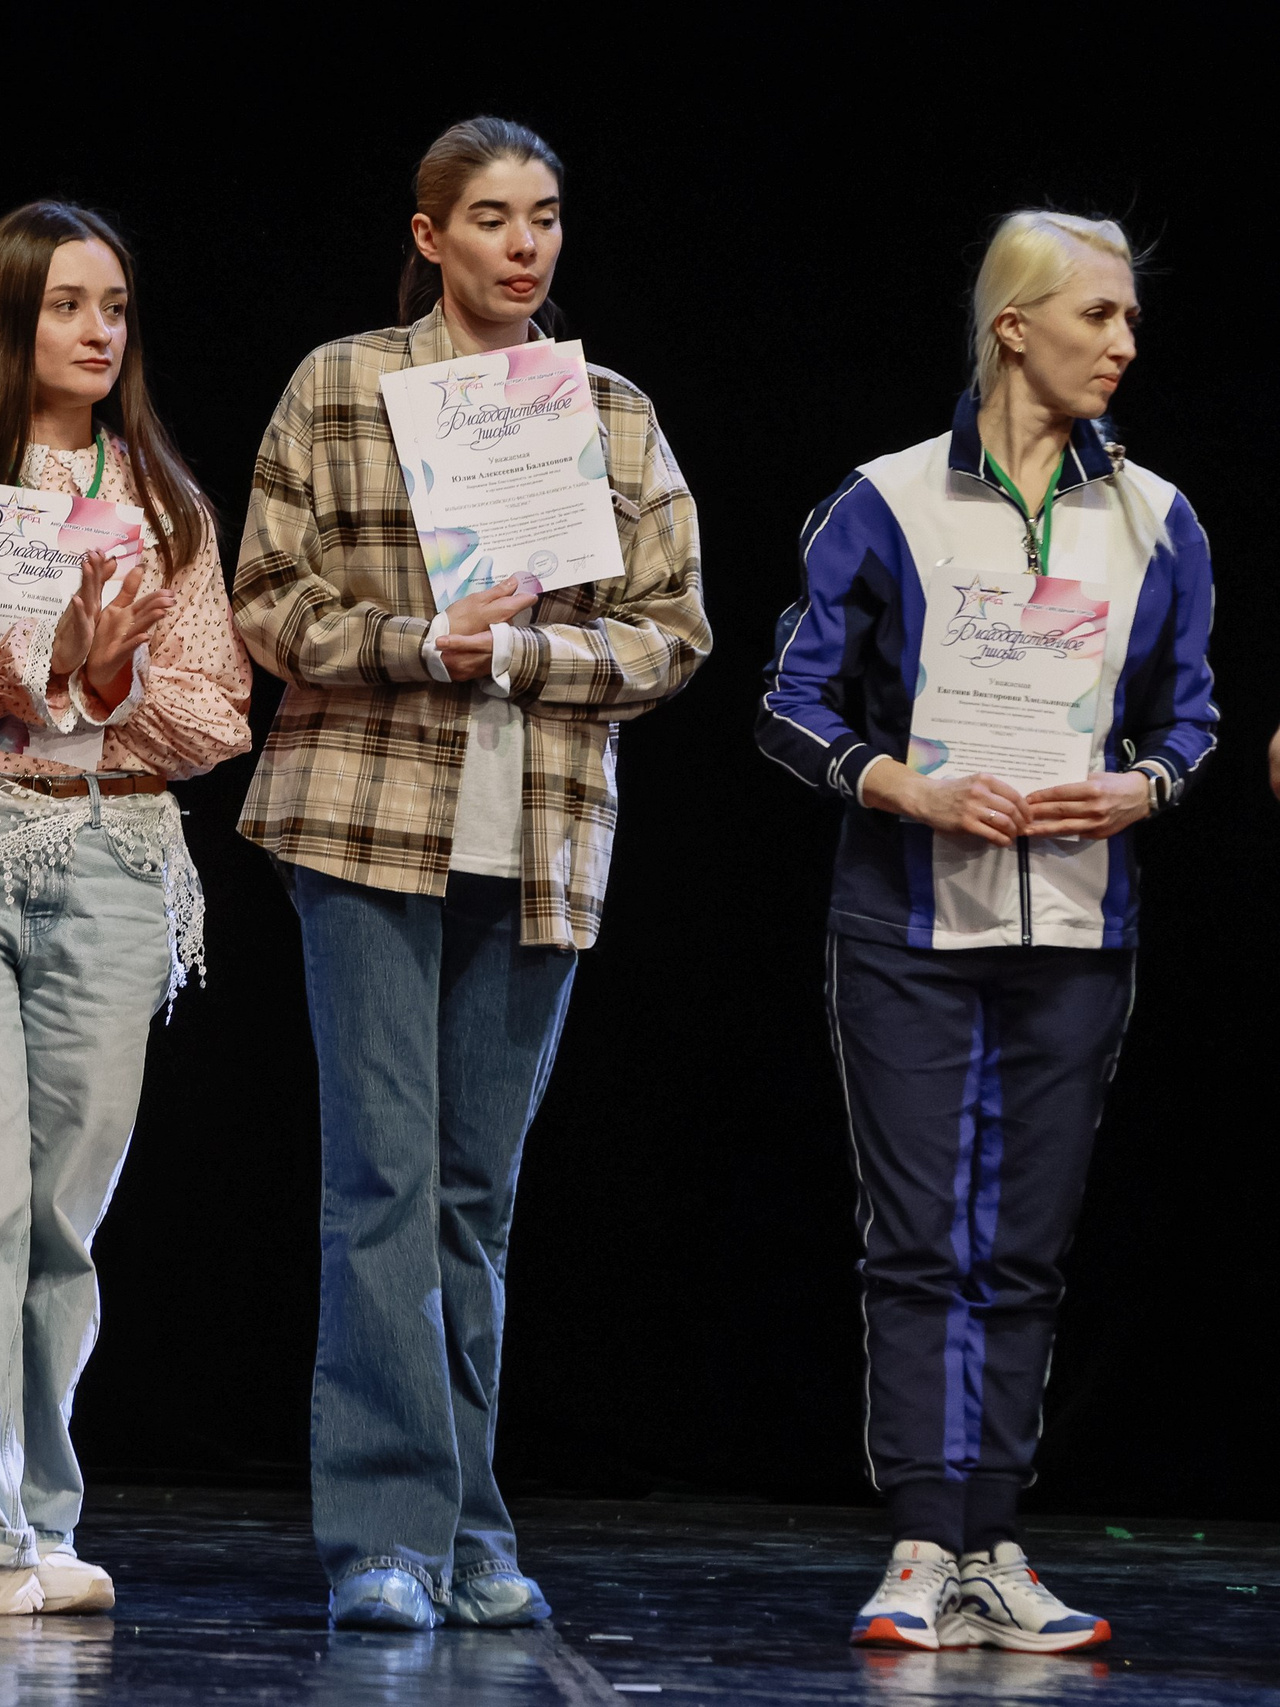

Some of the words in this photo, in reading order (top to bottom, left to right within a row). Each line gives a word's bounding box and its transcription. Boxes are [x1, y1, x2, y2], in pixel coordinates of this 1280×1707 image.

[436, 395, 572, 439] Благодарственное
[488, 452, 530, 464] Уважаемая
[451, 475, 476, 483] Юлия
[479, 466, 524, 479] Алексеевна
[526, 456, 573, 470] Балахонова
[21, 590, 62, 604] Уважаемая
[15, 603, 57, 616] Андреевна
[941, 616, 1085, 651] Благодарственное
